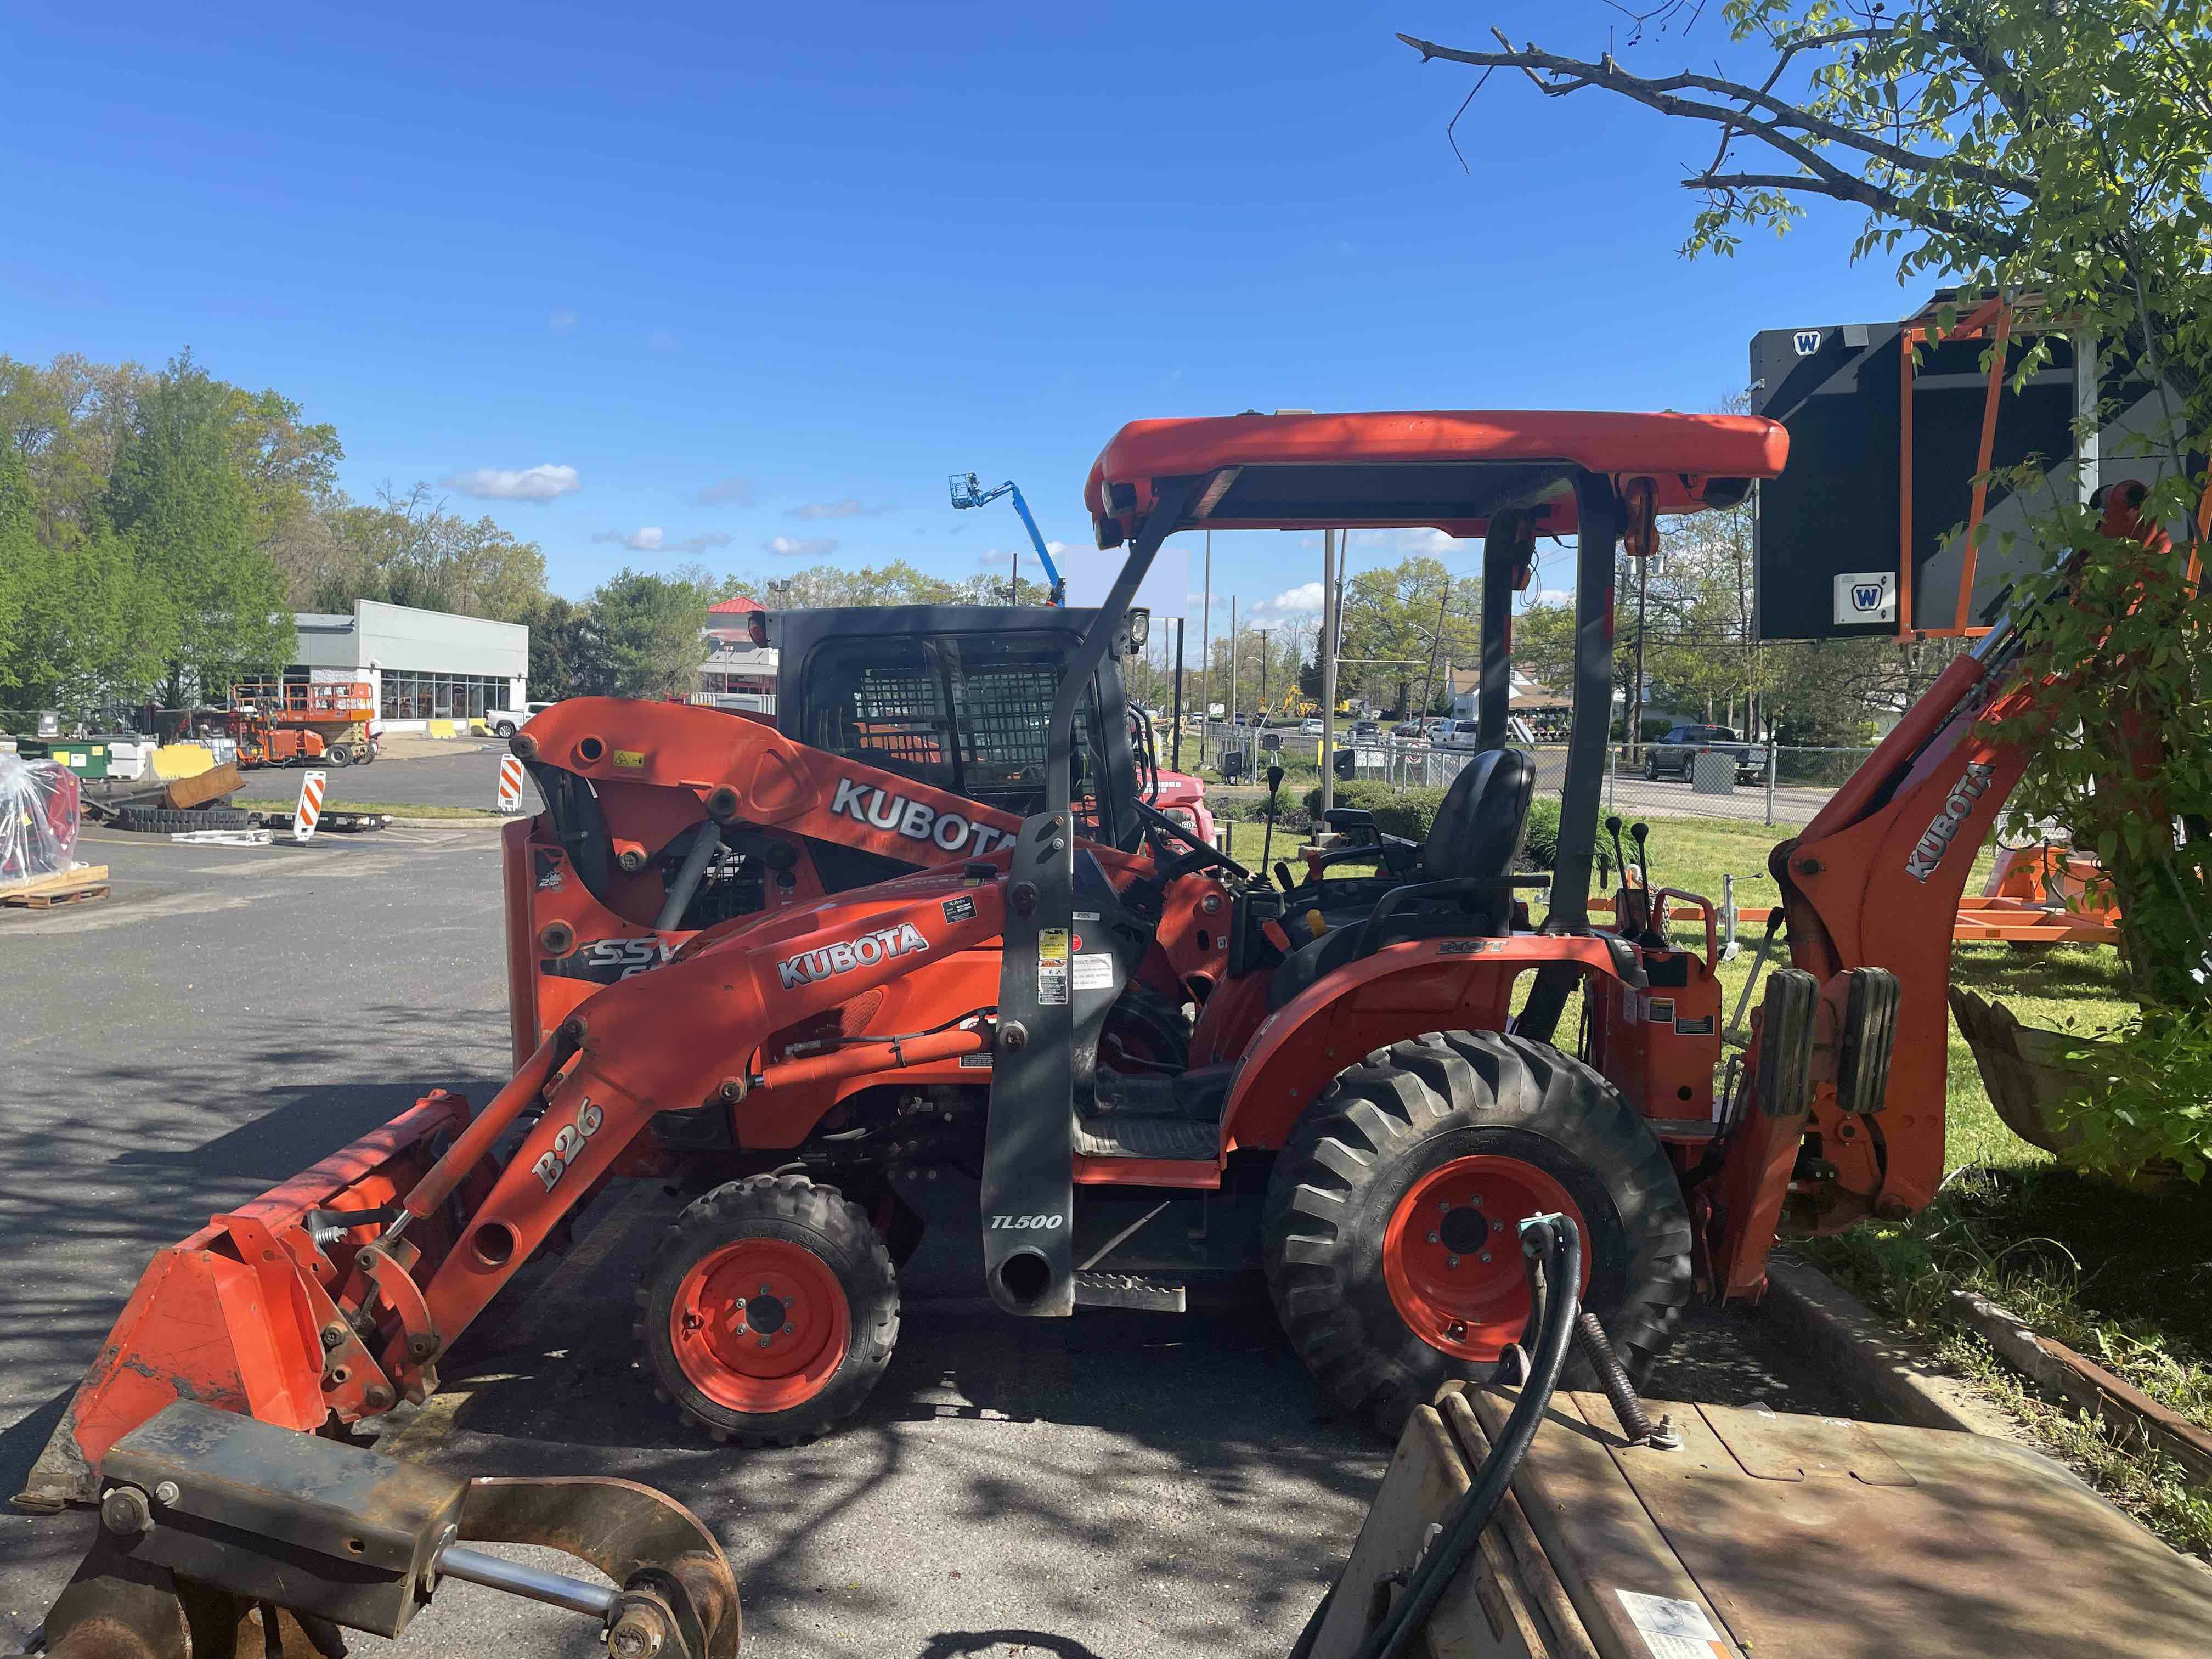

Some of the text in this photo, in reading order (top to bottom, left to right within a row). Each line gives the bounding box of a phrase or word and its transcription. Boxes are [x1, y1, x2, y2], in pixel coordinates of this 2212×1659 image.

[1797, 334, 1818, 352] W
[1856, 588, 1878, 606] W
[1905, 763, 1996, 882] KUBOTA
[777, 922, 928, 990] KUBOTA
[531, 1096, 603, 1193] B26
[991, 1215, 1063, 1229] TL500
